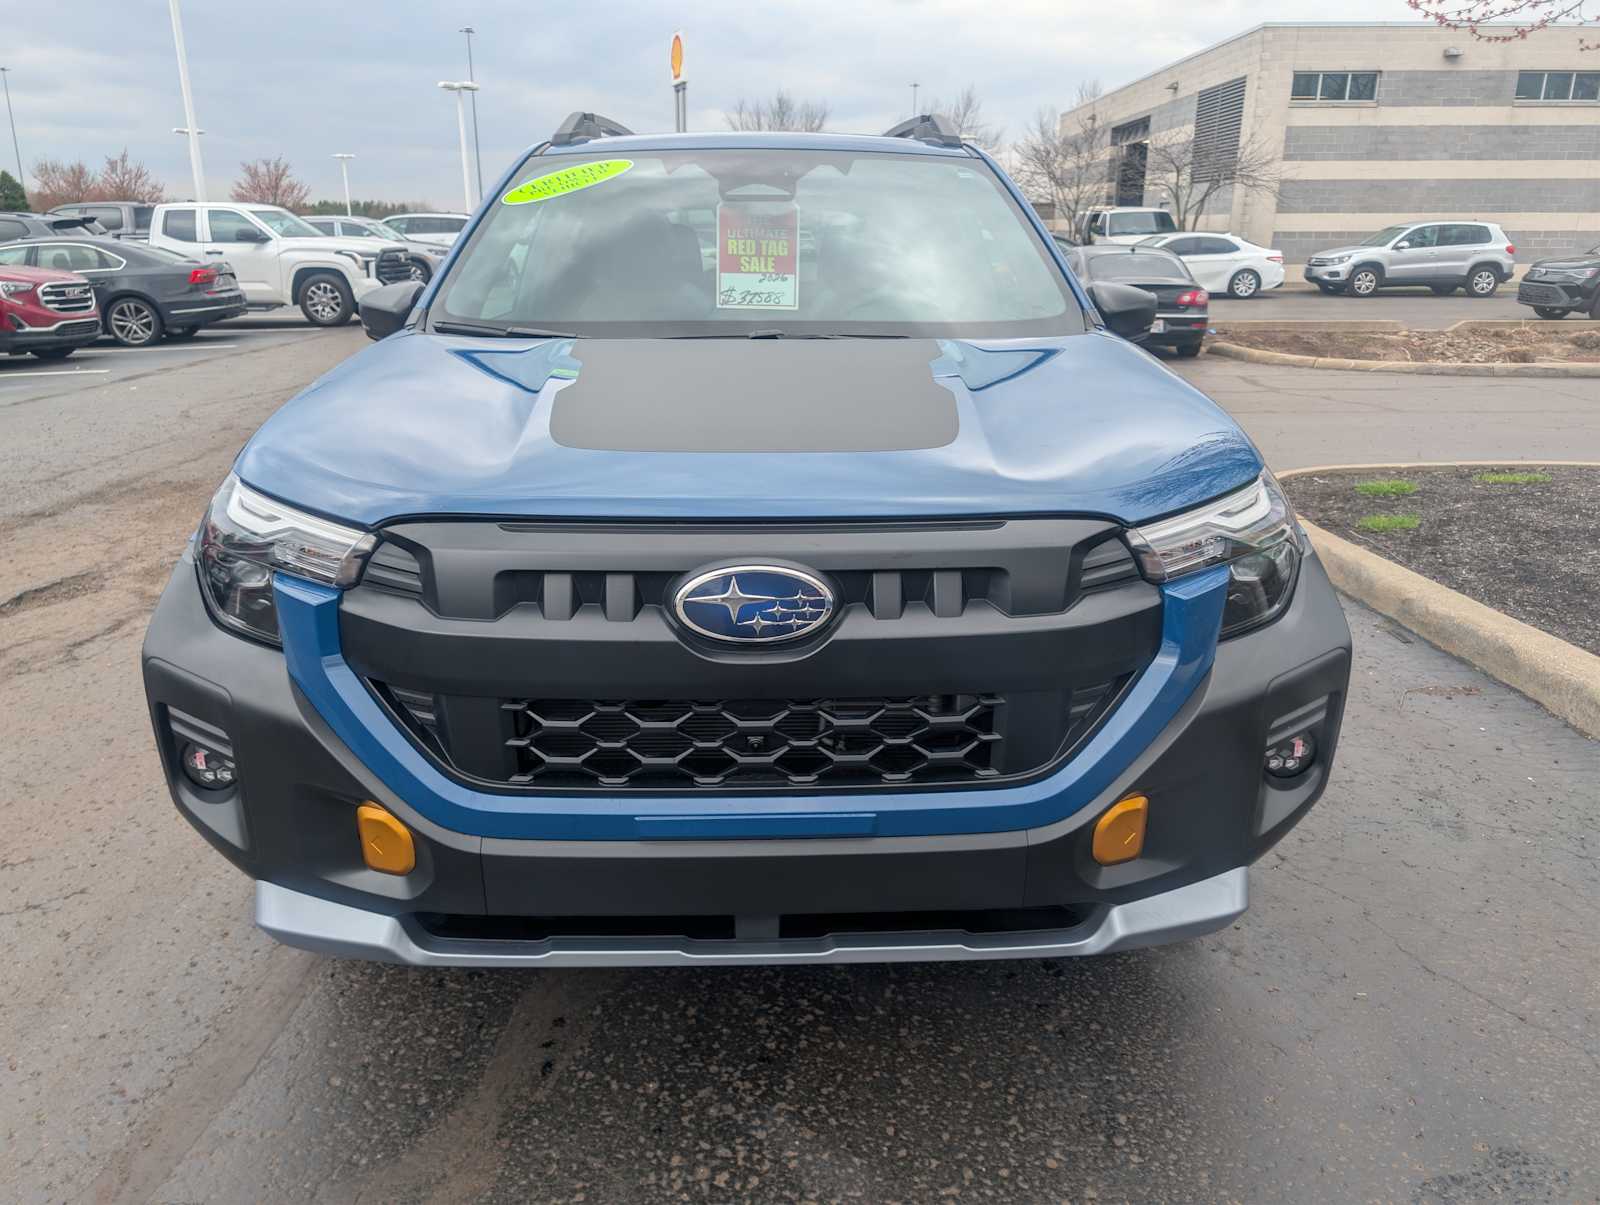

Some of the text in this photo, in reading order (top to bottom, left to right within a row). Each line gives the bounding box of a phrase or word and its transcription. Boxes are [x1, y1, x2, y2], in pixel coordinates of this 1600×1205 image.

[518, 162, 610, 193] CERTIFIED
[728, 228, 787, 239] ULTIMATE
[728, 239, 788, 256] RED TAG
[740, 256, 776, 272] SALE
